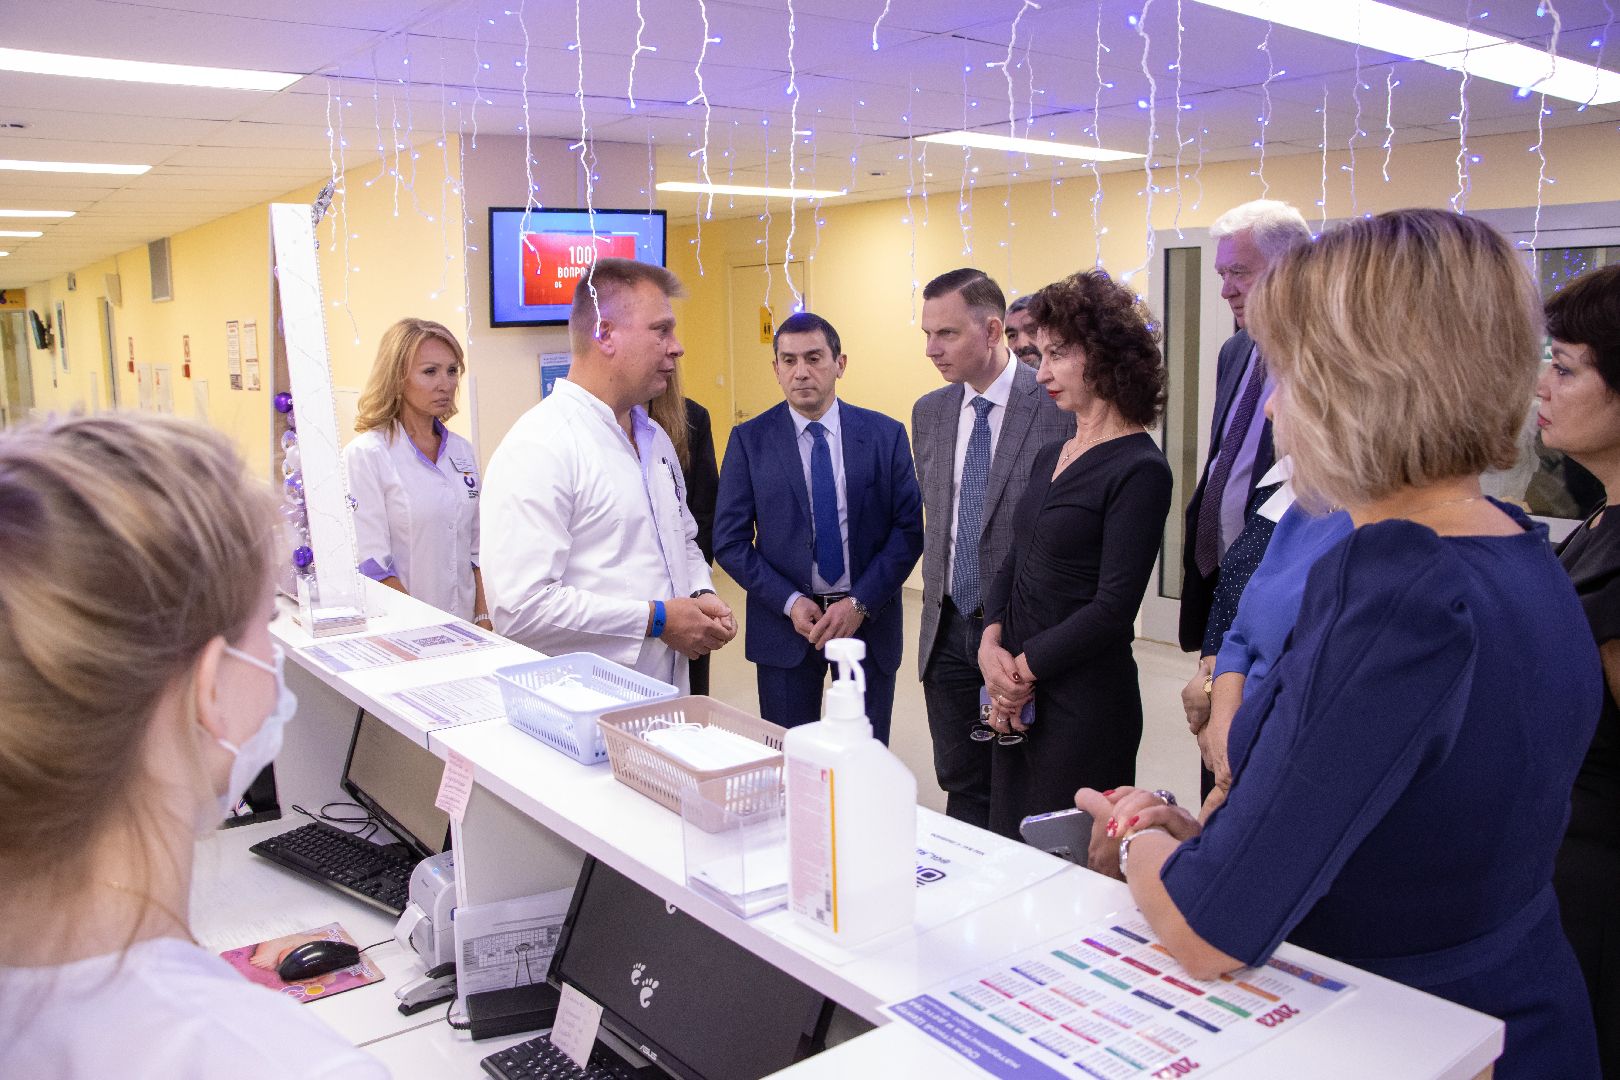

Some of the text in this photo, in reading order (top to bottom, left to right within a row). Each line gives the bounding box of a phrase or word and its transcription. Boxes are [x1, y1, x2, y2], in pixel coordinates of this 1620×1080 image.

[569, 245, 592, 265] 100
[557, 266, 586, 279] ВОПРО
[894, 1005, 926, 1026] Центр
[908, 1001, 948, 1024] детства
[1256, 1004, 1300, 1027] 2023
[923, 1022, 980, 1060] Областной
[954, 1027, 1021, 1069] материнства
